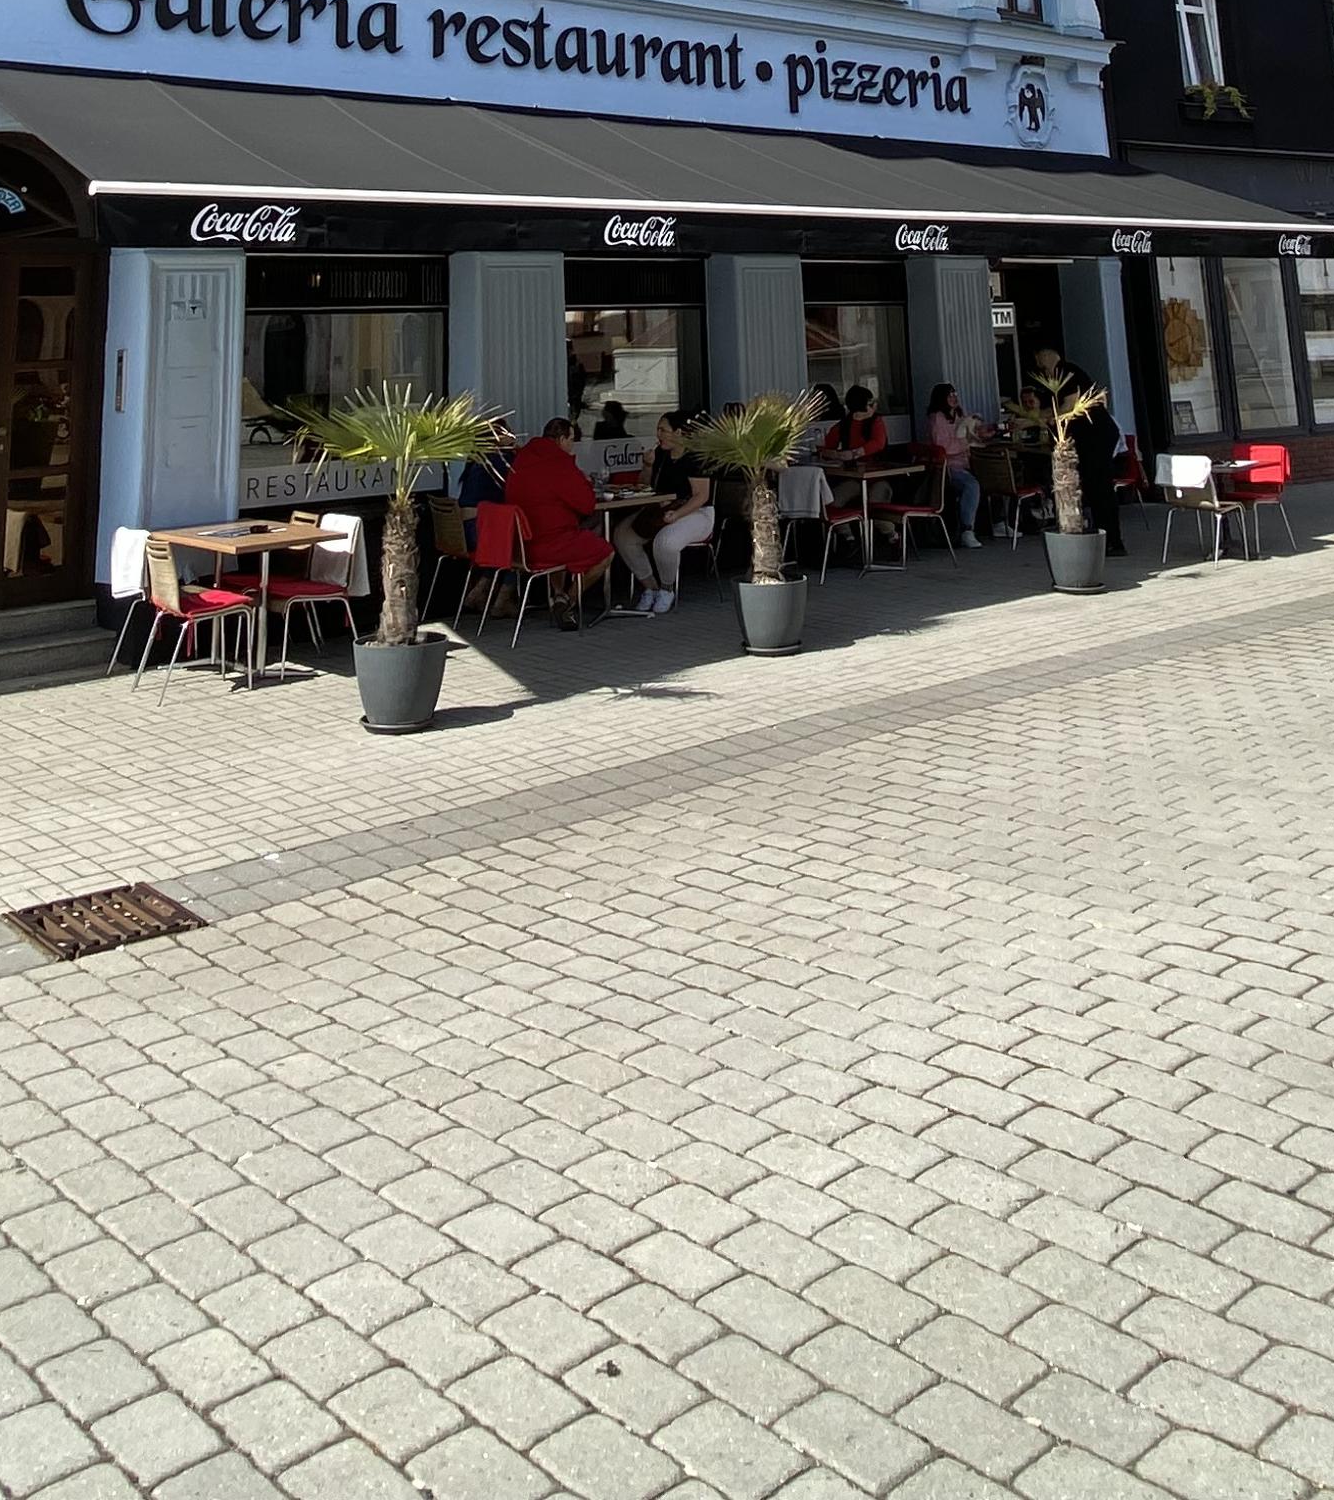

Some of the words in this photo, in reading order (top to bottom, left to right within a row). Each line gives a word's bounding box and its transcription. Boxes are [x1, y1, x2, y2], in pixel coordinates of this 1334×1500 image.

[427, 6, 746, 91] restaurant
[783, 39, 972, 114] pizzeria
[190, 203, 301, 242] Coca-Cola
[604, 214, 677, 247] Coca-Cola
[895, 223, 950, 251] Coca-Cola
[992, 311, 1012, 324] TM
[603, 444, 645, 468] Galeri
